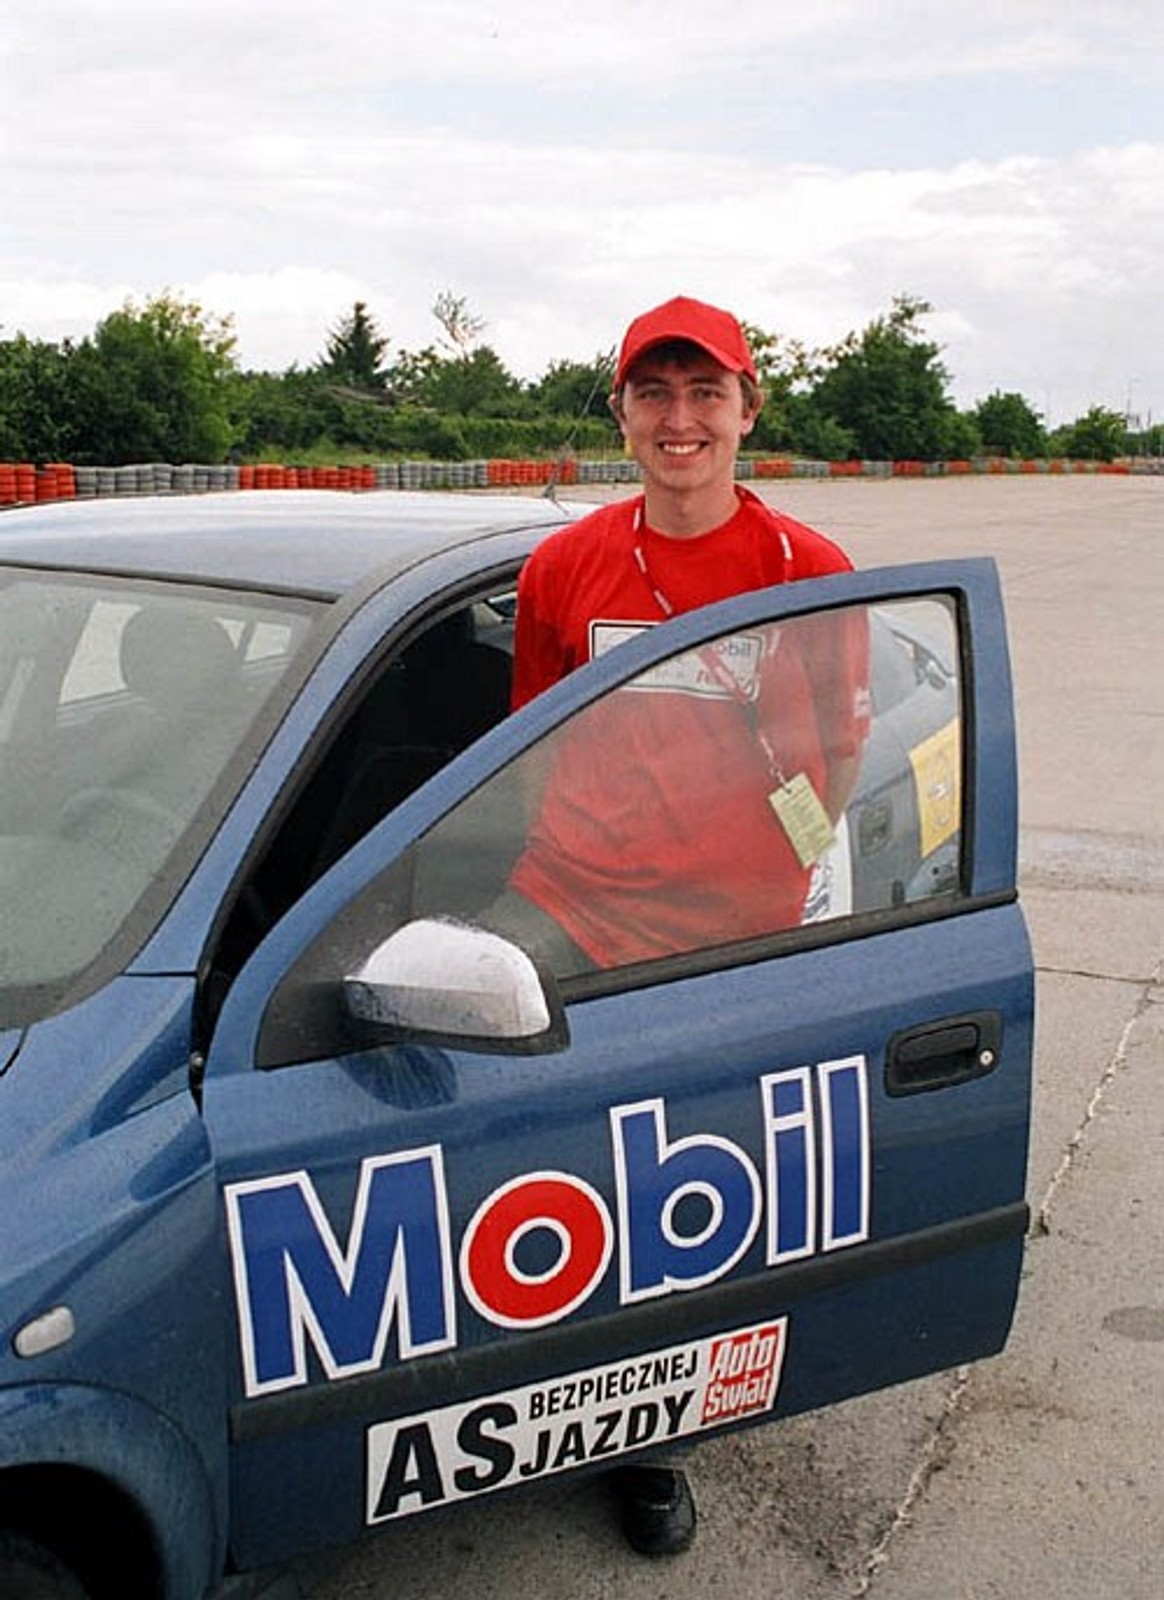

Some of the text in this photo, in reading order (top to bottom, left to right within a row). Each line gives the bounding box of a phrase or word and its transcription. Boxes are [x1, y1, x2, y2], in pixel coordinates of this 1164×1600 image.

[224, 1054, 869, 1398] Mobil
[528, 1350, 698, 1420] BEZPIECZNEJ
[710, 1332, 777, 1381] Auto
[372, 1401, 518, 1518] AS
[519, 1389, 696, 1477] JAZDY
